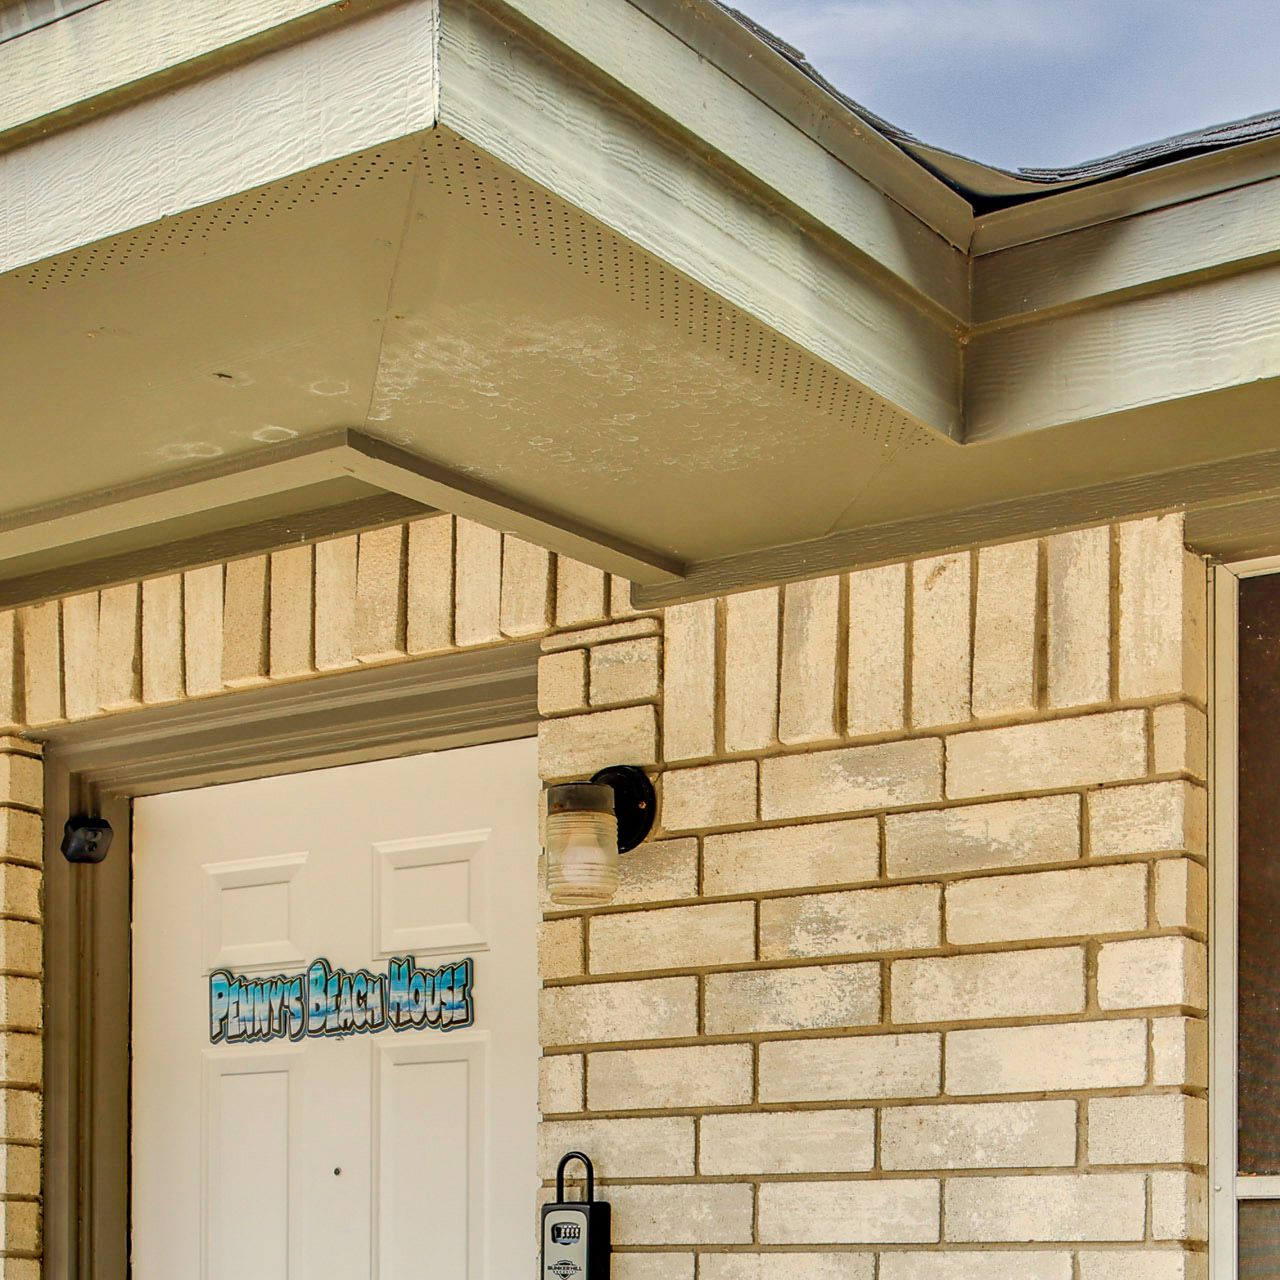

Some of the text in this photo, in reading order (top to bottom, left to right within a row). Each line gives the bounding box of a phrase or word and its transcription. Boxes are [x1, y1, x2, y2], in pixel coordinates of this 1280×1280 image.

[210, 955, 473, 1043] PENNY'S BEACH HOUSE
